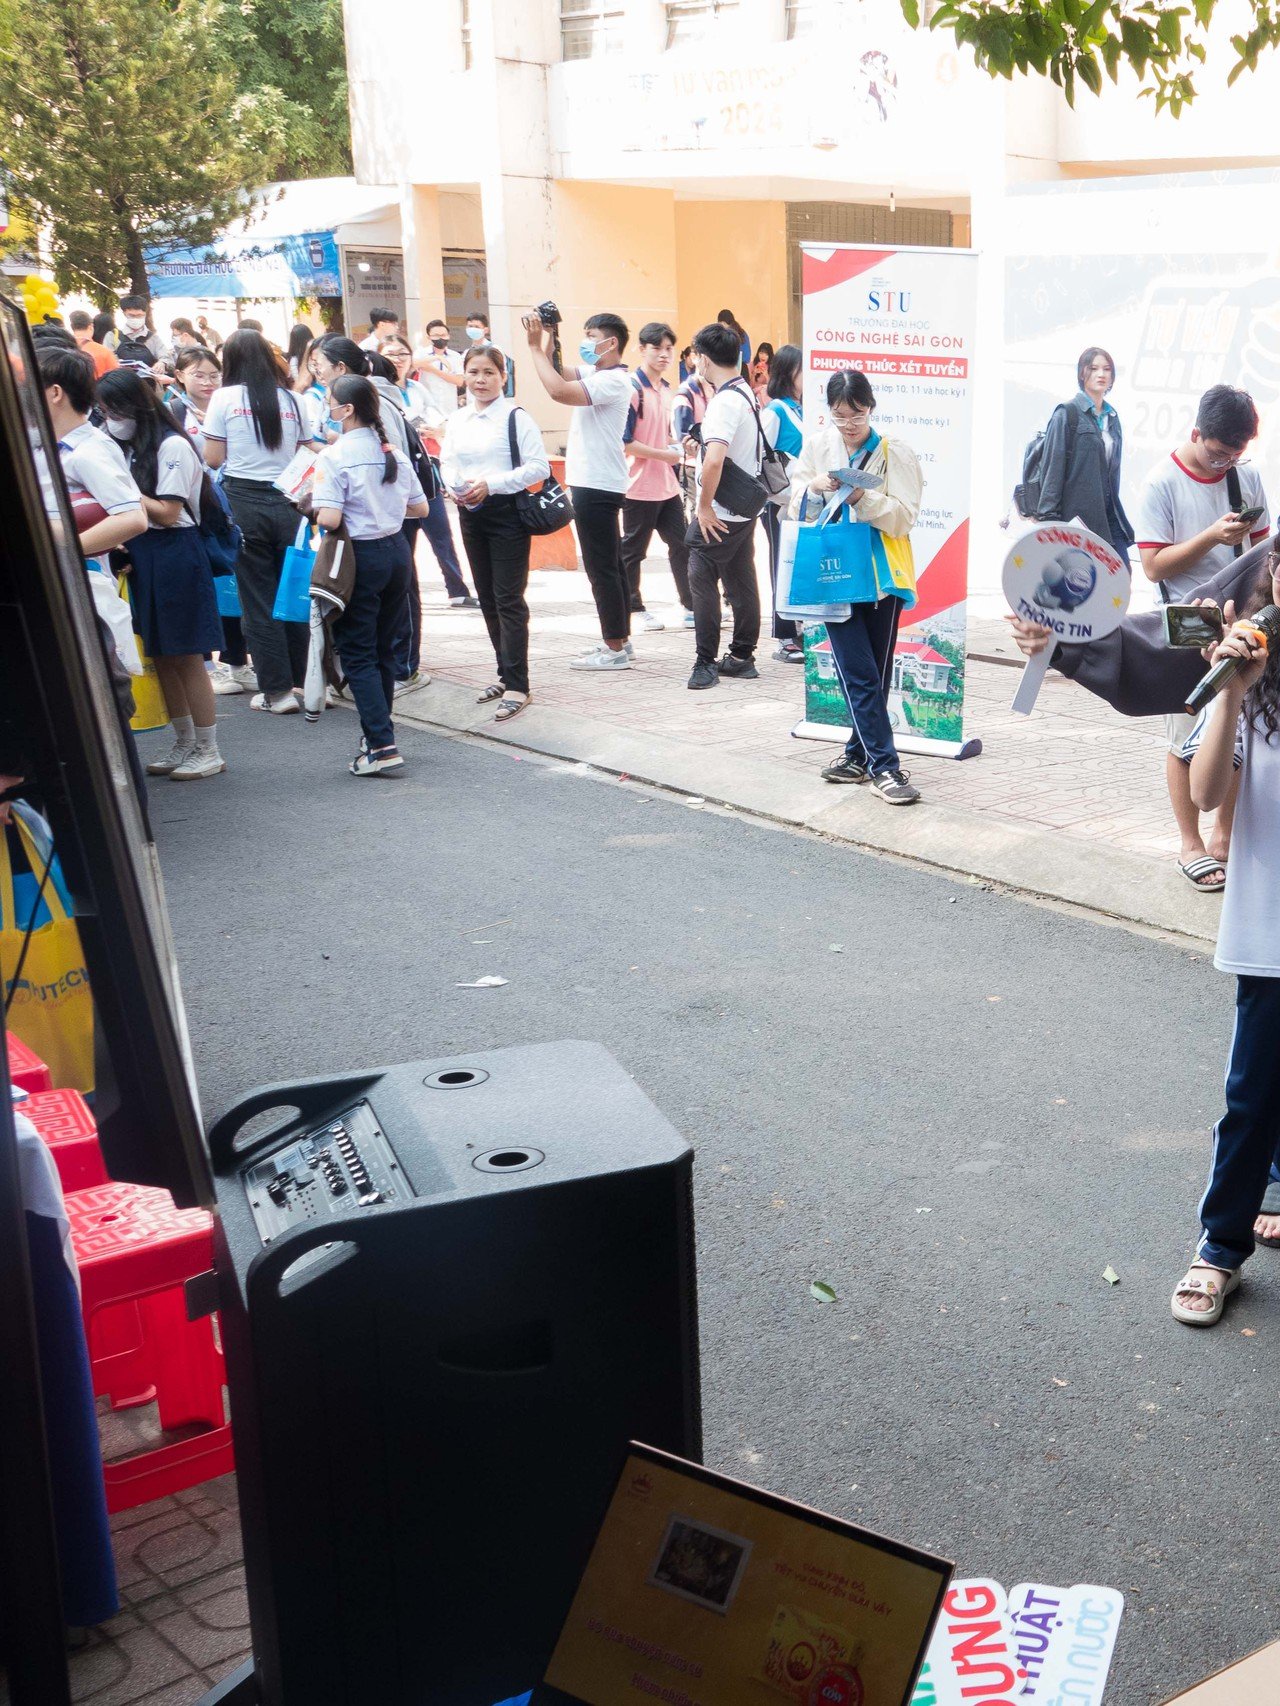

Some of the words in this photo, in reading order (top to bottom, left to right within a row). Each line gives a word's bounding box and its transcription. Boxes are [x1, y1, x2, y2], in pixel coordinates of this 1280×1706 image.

[720, 101, 785, 135] 2024
[868, 290, 912, 313] STU
[815, 328, 856, 343] CÔNG
[860, 331, 899, 348] NGHỆ
[812, 357, 863, 371] PHƯƠNG
[865, 358, 898, 373] THỨC
[899, 362, 923, 374] XÉT
[924, 360, 964, 376] TUYỂN
[819, 384, 824, 395] 1
[911, 386, 920, 394] 11
[935, 386, 949, 397] học
[818, 415, 825, 426] 2
[896, 415, 906, 424] 11
[919, 415, 933, 427] học
[1132, 400, 1195, 442] 202
[925, 520, 947, 531] Minh.
[819, 558, 841, 571] STU
[1068, 622, 1093, 637] TIN
[945, 1586, 1028, 1697] ỰNG
